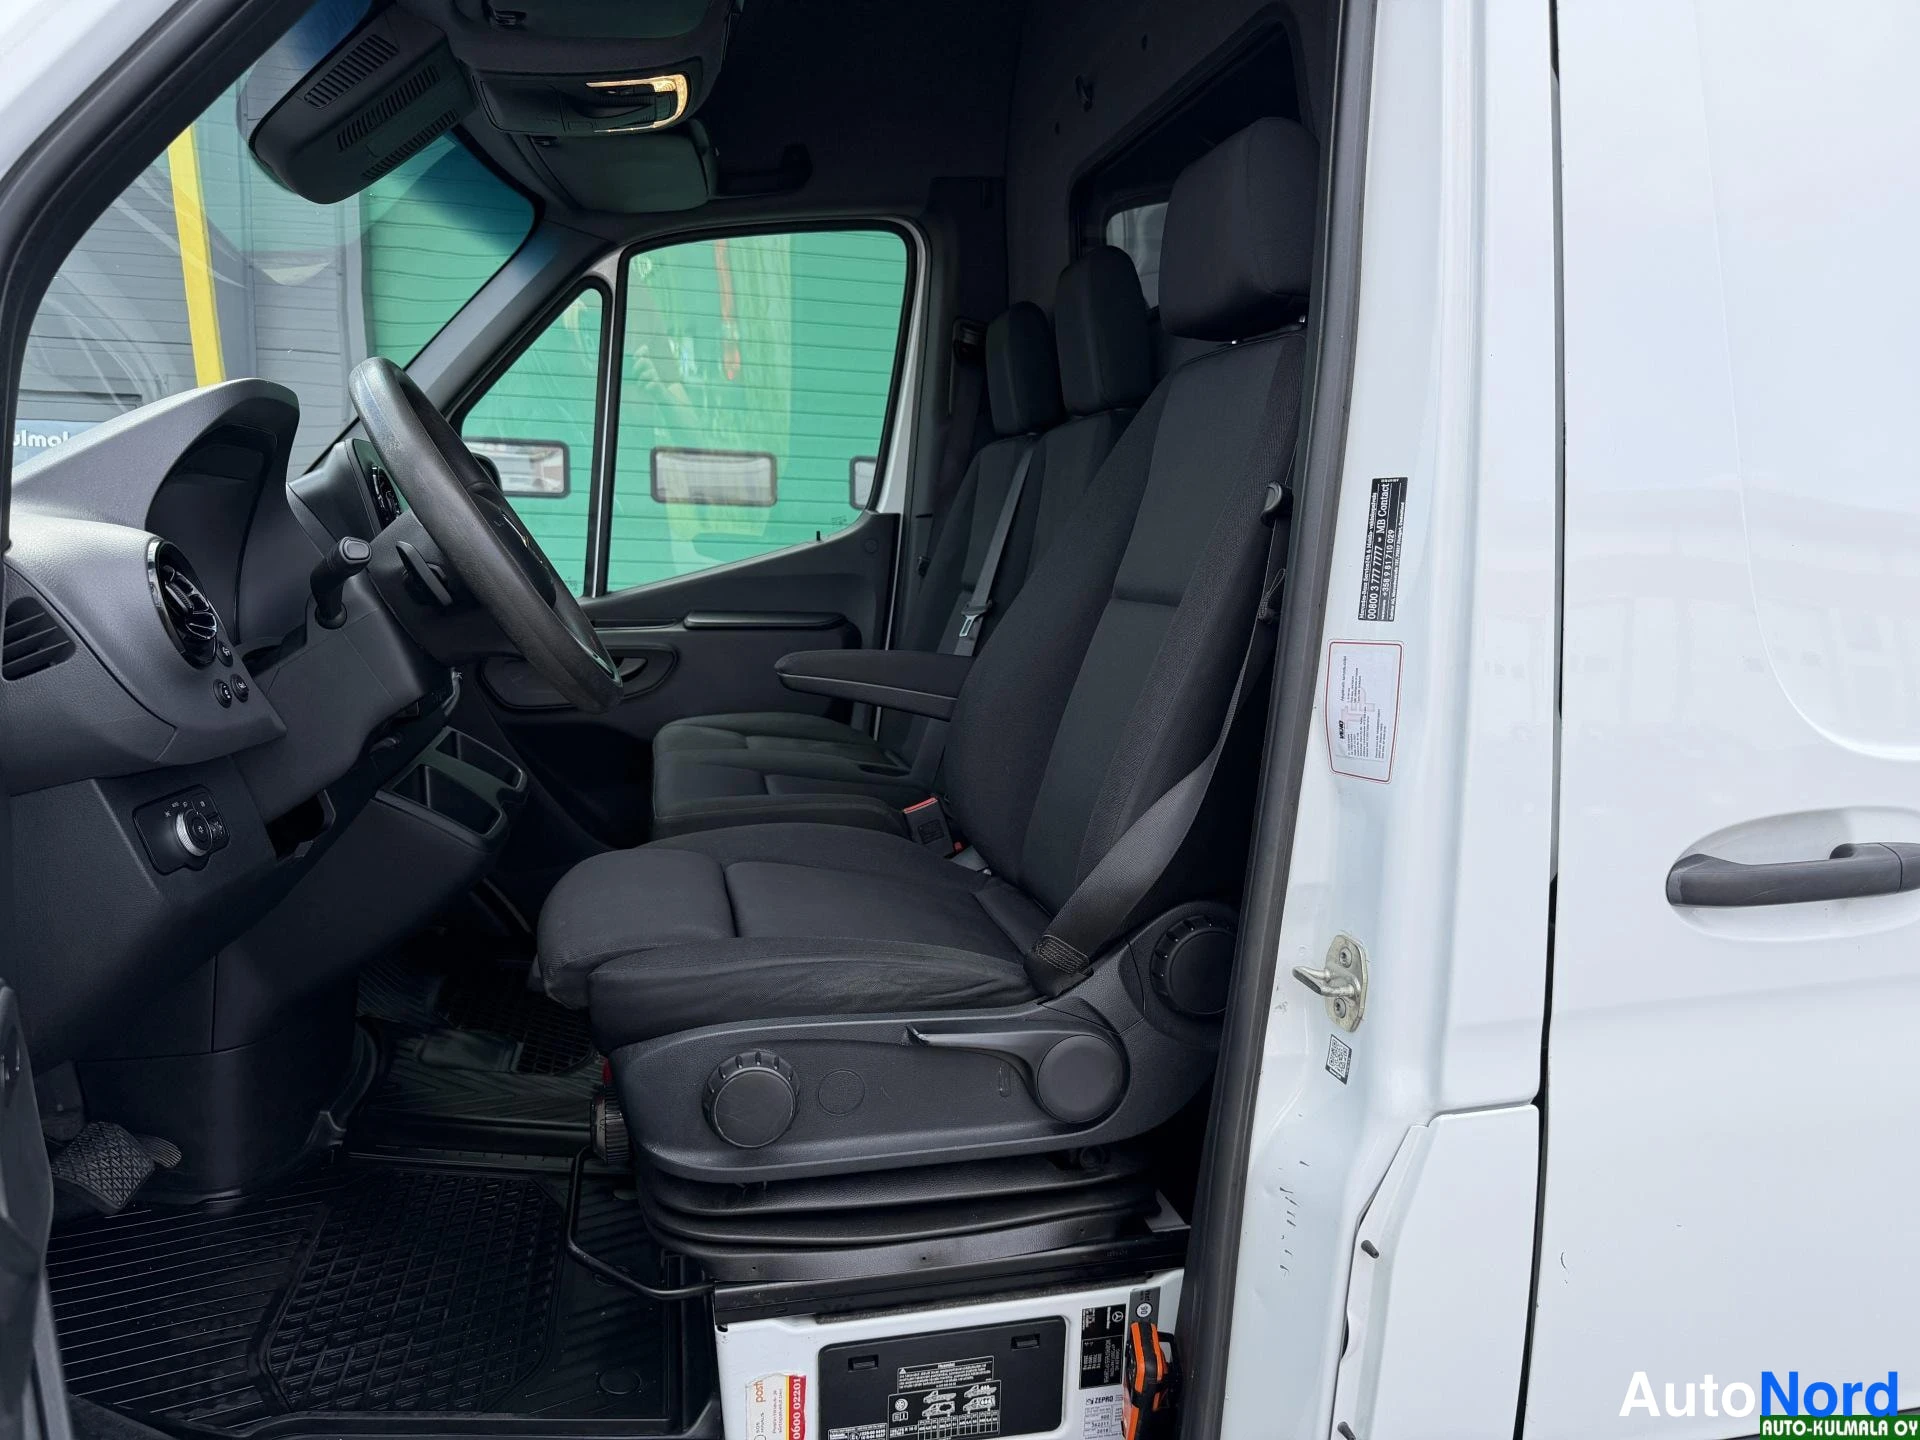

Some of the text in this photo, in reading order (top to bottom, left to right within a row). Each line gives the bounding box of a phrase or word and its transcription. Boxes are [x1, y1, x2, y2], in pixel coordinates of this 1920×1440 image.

[1378, 483, 1390, 517] Contact
[1376, 519, 1386, 534] MB
[1387, 529, 1395, 544] 029
[1373, 545, 1383, 566] 7777
[1385, 561, 1391, 570] 81
[1371, 568, 1381, 584] 777
[1382, 578, 1390, 597] +358
[1367, 593, 1378, 620] 00800
[1140, 1306, 1148, 1315] 90
[1094, 1395, 1114, 1404] ZEPRO
[790, 1378, 801, 1440] 0600 02201
